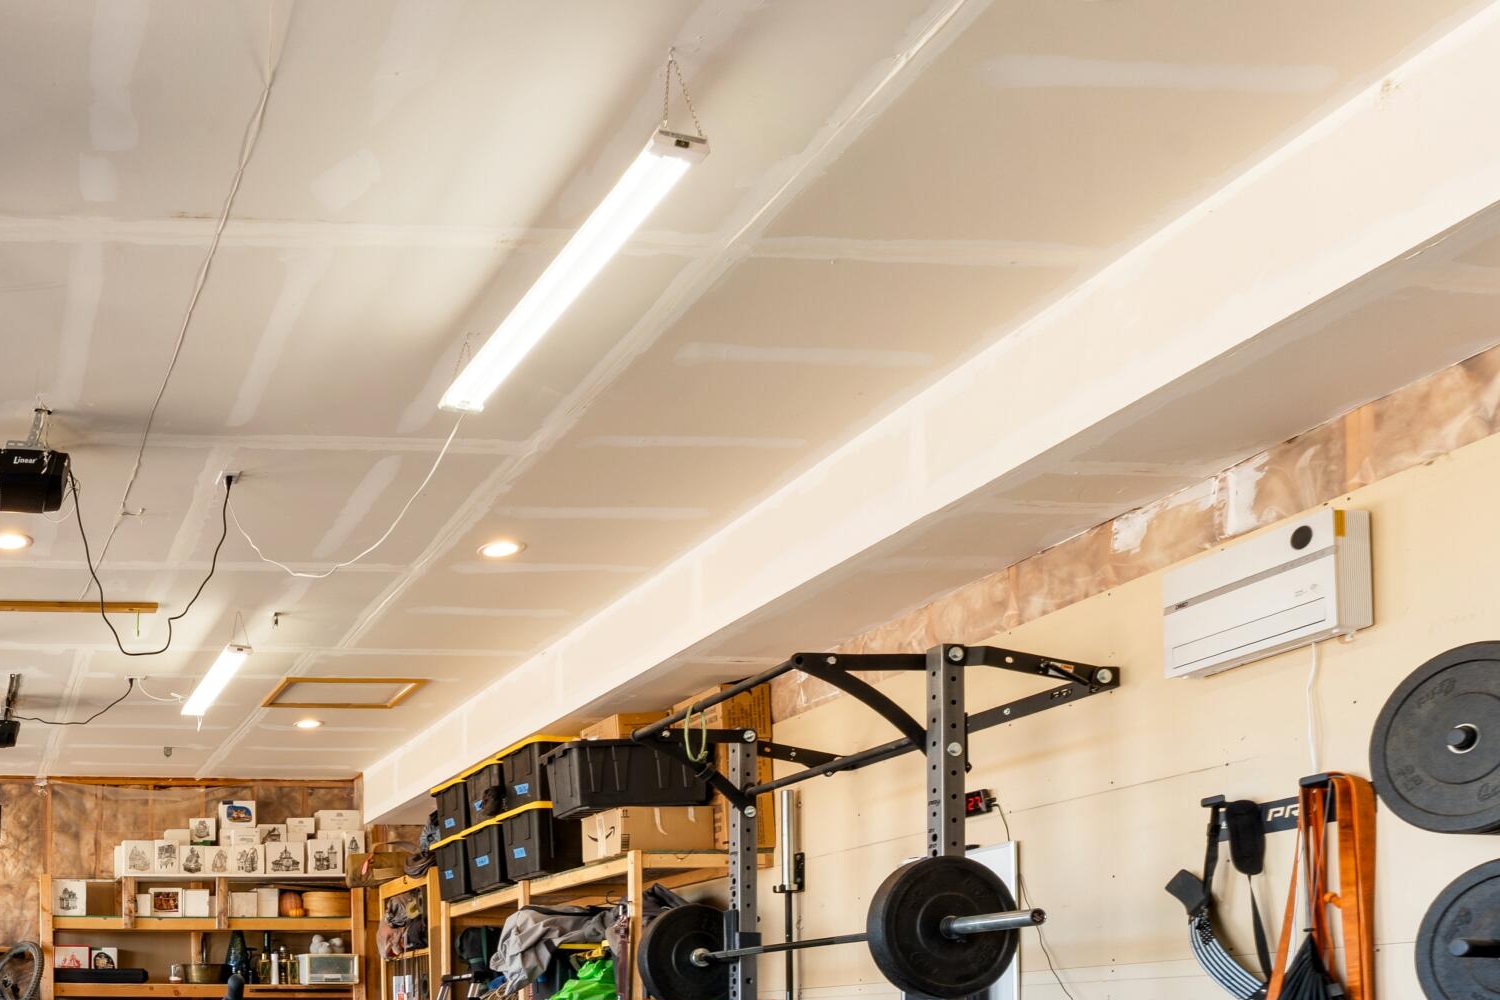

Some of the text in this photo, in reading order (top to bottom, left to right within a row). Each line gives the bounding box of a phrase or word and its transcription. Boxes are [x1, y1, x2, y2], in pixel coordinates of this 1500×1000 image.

[13, 456, 36, 464] Linear
[967, 796, 981, 811] 27
[1266, 803, 1300, 822] PR
